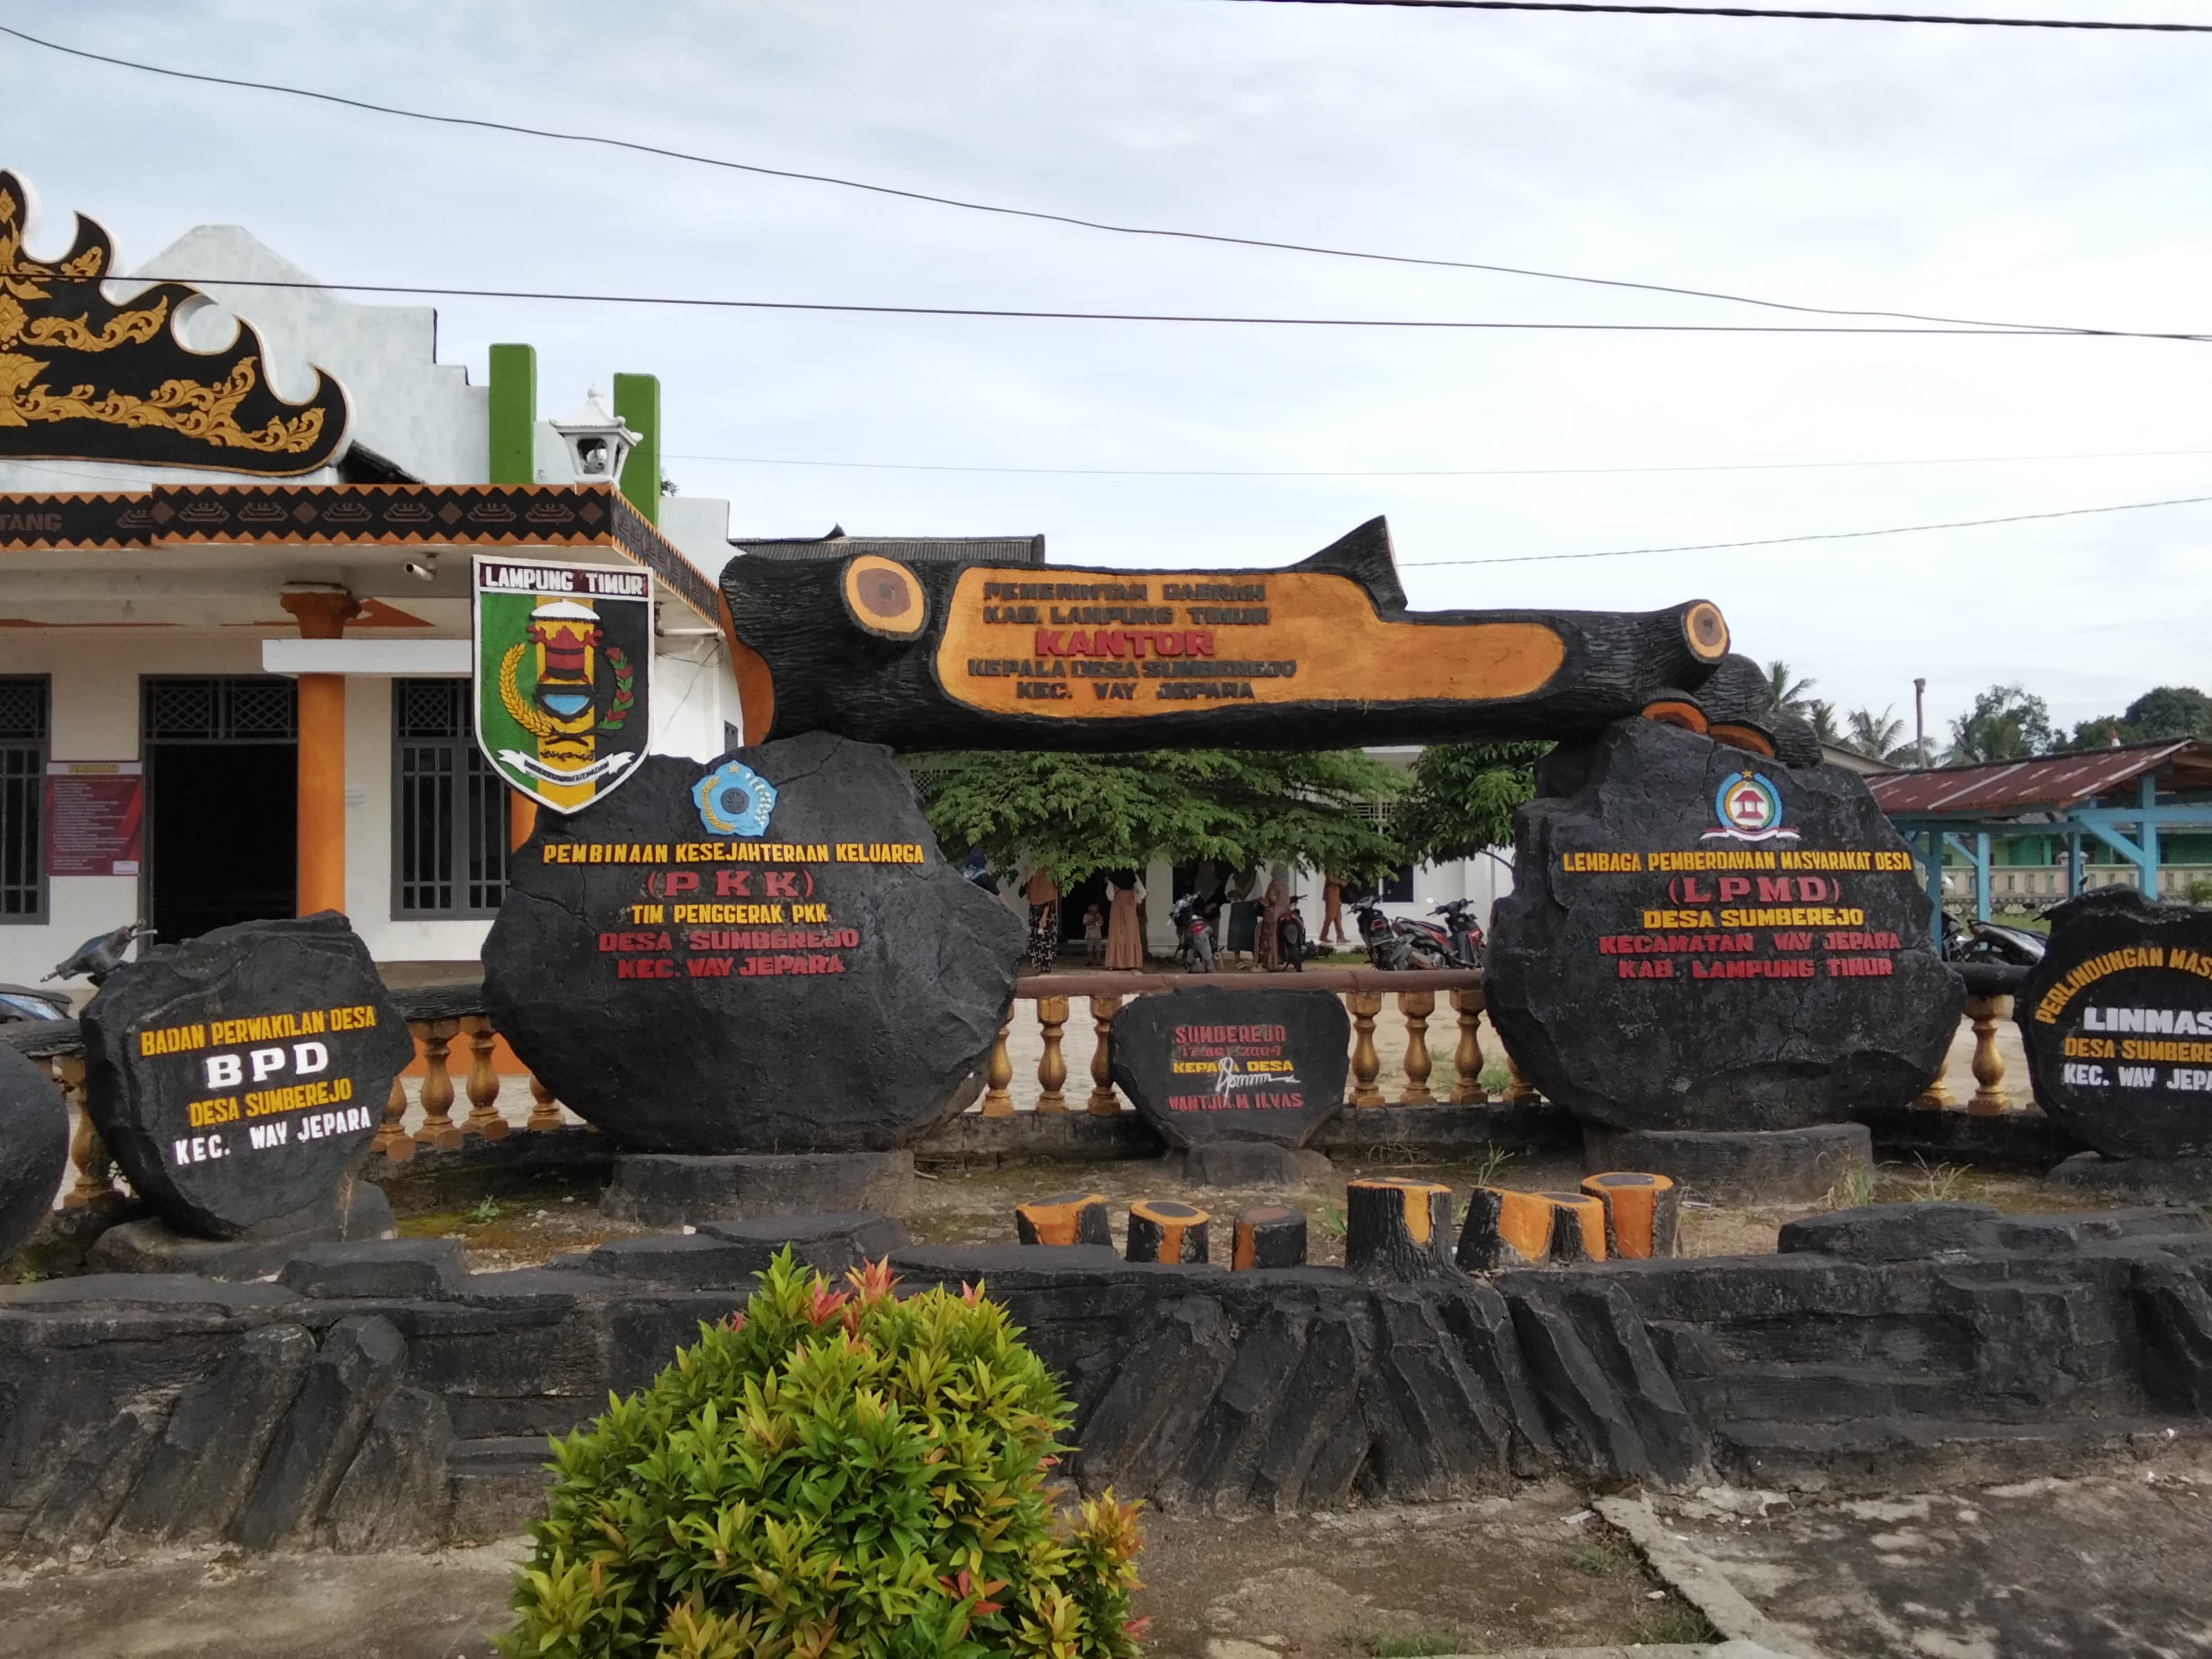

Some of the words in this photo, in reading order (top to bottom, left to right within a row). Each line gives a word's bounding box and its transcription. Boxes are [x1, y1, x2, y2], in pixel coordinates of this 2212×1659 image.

[485, 565, 574, 592] LAMPUNG
[586, 572, 644, 595] TIMUR
[984, 582, 1148, 601] PEMERINTAH
[1163, 583, 1266, 600] DAERAH
[984, 606, 1042, 624] KAB.
[1050, 606, 1174, 624] LAMPUNG
[1186, 607, 1271, 624] TIMUR
[1035, 630, 1215, 657] KANTOR
[968, 659, 1067, 677] KEPALA
[1071, 659, 1138, 677] DESA
[1143, 659, 1297, 678] SUMBEREJO
[1016, 682, 1072, 699] KEC.
[1094, 682, 1138, 699] WAY
[1155, 682, 1255, 699] JEPARA
[543, 844, 668, 863] PEMBINAAN
[675, 843, 830, 863] KESEJAHTERAAN
[835, 843, 925, 863] KELUARGA
[1562, 852, 1642, 872] LEMBAGA
[1648, 851, 1776, 871] PEMBERDAYAAN
[1781, 851, 1871, 871] MASYARAKAT
[1875, 852, 1913, 871] DESA
[632, 904, 664, 924] TIM
[674, 903, 783, 924] PENGGERAK
[793, 903, 828, 923] PKK
[1642, 909, 1715, 930] DESA
[1721, 907, 1864, 928] SUMBEREJO
[598, 931, 673, 952] DESA
[689, 929, 859, 950] SUMBEREJO
[1598, 934, 1754, 955] KECAMATAN
[1772, 932, 1814, 951] WAY
[1822, 931, 1902, 951] JEPARA
[617, 958, 682, 980] KEC.
[687, 957, 735, 978] WAY
[738, 954, 845, 977] JEPARA
[1691, 959, 1816, 979] LAMPUNG
[1826, 957, 1893, 977] TIMUR
[2035, 947, 2163, 1025] PERLINDUNGAN
[2168, 948, 2212, 981] MAS
[140, 1024, 205, 1056] BADAN
[211, 1010, 326, 1047] PERWAKILAN
[329, 1005, 377, 1032] DESA
[2083, 1007, 2212, 1035] LINMAS
[1174, 1024, 1286, 1044] SUMBEREJO
[2064, 1036, 2116, 1058] DESA
[205, 1041, 329, 1089] BPD
[1246, 1060, 1294, 1072] DESA
[2063, 1062, 2110, 1086] KEC.
[2118, 1065, 2156, 1088] WAY
[188, 1096, 241, 1128] DESA
[244, 1078, 353, 1116] SUMBEREJO
[174, 1134, 231, 1165] KEC.
[250, 1121, 288, 1150] WAY
[297, 1105, 373, 1145] JEPARA
